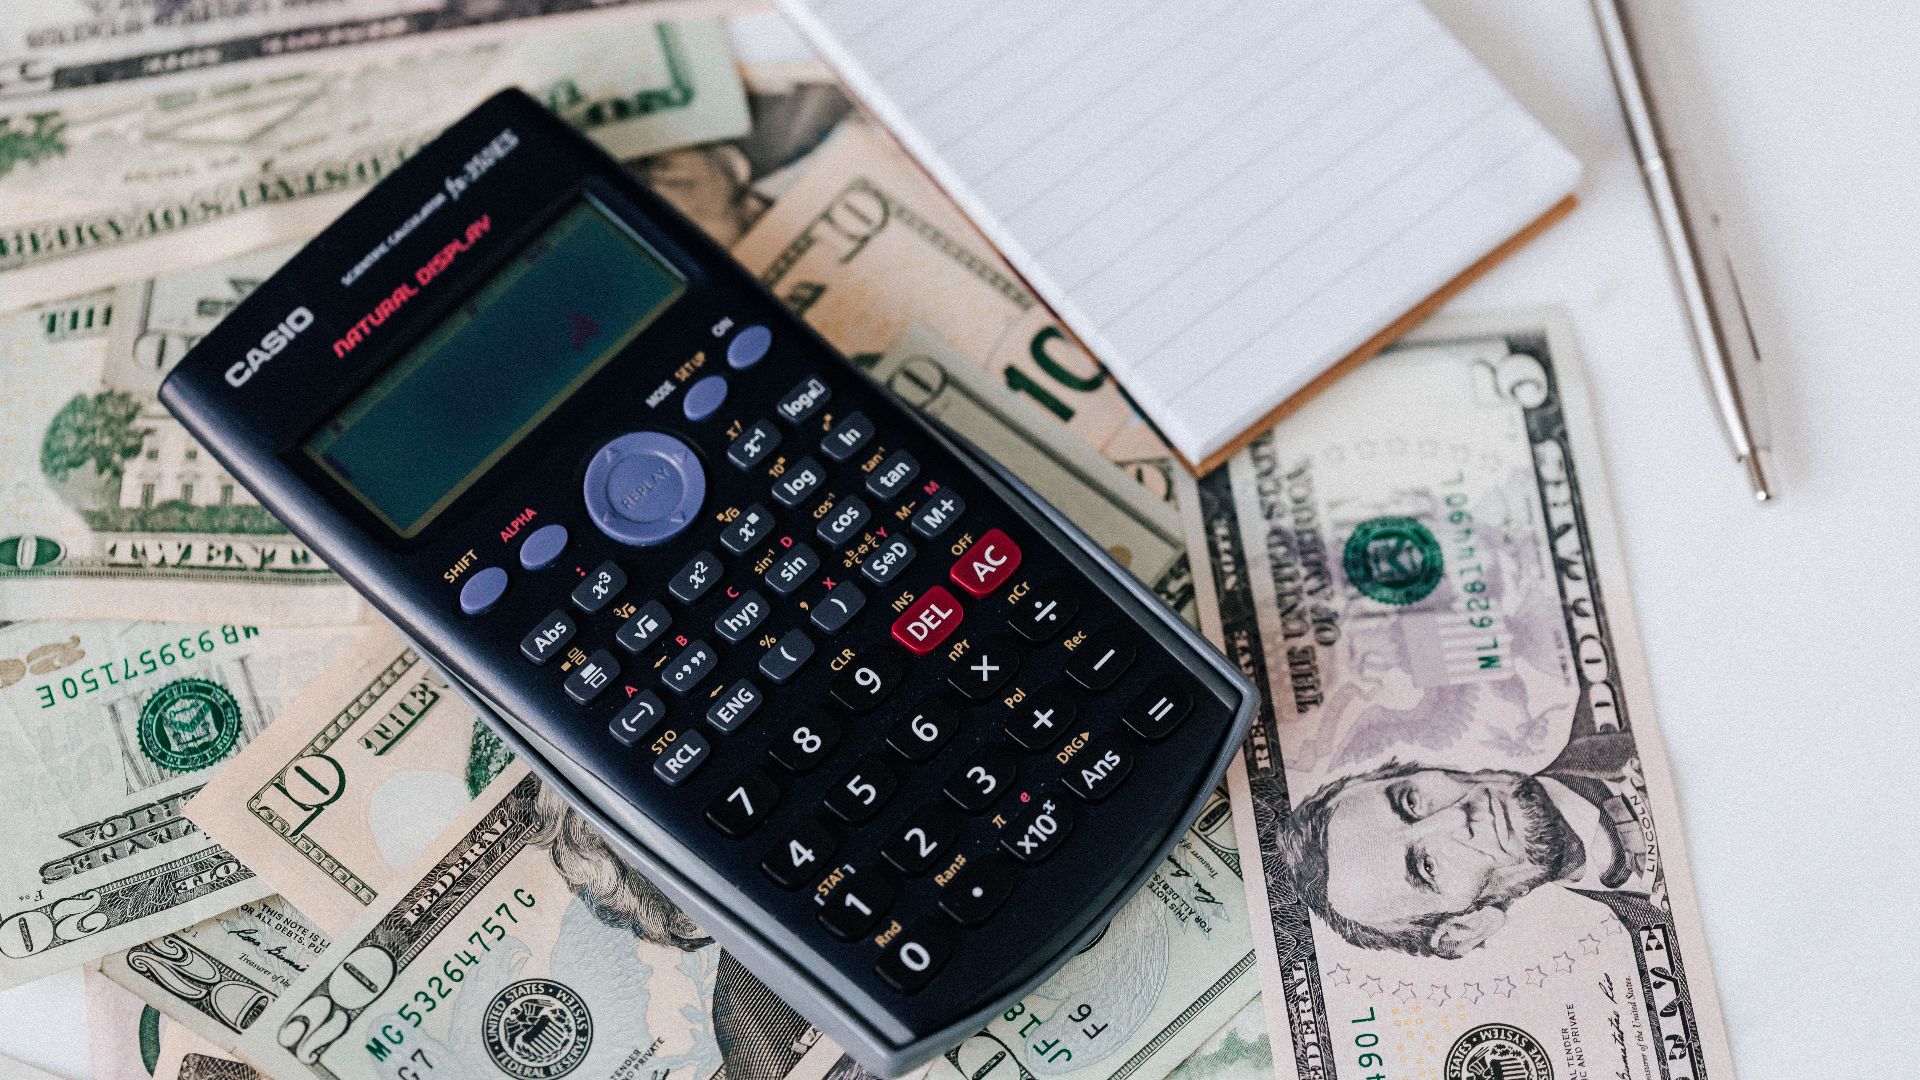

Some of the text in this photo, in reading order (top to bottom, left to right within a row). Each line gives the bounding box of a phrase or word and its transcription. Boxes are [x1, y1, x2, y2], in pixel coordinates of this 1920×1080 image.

[332, 212, 492, 359] NATURAL DISPLAY
[711, 316, 735, 338] ON
[224, 306, 315, 388] CASIO
[645, 379, 677, 408] MODE
[838, 427, 862, 447] ln
[622, 466, 671, 510] REPLAY
[783, 469, 817, 496] log
[880, 461, 910, 488] tan
[923, 480, 940, 496] M
[500, 507, 538, 543] ALPHA
[832, 507, 860, 533] cos
[923, 498, 954, 529] M+
[780, 536, 793, 548] D
[876, 527, 889, 540] Y
[951, 532, 974, 556] OFF
[443, 548, 478, 583] SHIFT
[780, 556, 807, 581] sin
[972, 544, 1008, 583] AC
[726, 586, 740, 599] C
[891, 591, 915, 613] INS
[1007, 581, 1031, 605] nCr
[724, 601, 759, 632] hyp
[906, 603, 953, 641] DEL
[534, 621, 567, 653] Abs
[675, 634, 688, 647] B
[759, 634, 777, 649] %
[948, 638, 971, 662] nPr
[1063, 630, 1088, 652] Rec
[830, 648, 856, 671] CLR
[624, 685, 638, 698] A
[854, 667, 882, 695] 9
[1287, 645, 1324, 714] THE
[717, 687, 755, 724] ENG
[1004, 687, 1027, 709] Pol
[651, 730, 677, 755] STO
[792, 726, 822, 754] 8
[911, 714, 939, 742] 6
[665, 743, 702, 775] RCL
[1081, 750, 1121, 790] Ans
[846, 774, 877, 806] 5
[966, 765, 997, 795] 3
[727, 786, 754, 816] 7
[1020, 792, 1031, 803] e
[904, 827, 938, 858] 2
[1630, 795, 1657, 873] LINCOLN
[39, 817, 203, 884] TATES
[789, 839, 815, 868] 4
[402, 815, 518, 928] FEDERAL
[934, 854, 967, 887] Ran#
[844, 893, 872, 916] 1
[1147, 881, 1169, 905] NOTE
[1178, 899, 1196, 916] ALL
[0, 889, 109, 960] 20
[255, 911, 272, 927] ALL
[261, 904, 283, 921] THIS
[283, 917, 311, 938] NOTE
[309, 932, 321, 944] IS
[1169, 904, 1188, 923] THIS
[1194, 915, 1213, 934] FOR
[874, 920, 903, 948] Rnd
[238, 952, 271, 977] Treasurer
[899, 941, 931, 972] 0
[276, 944, 399, 1066] 20
[487, 983, 546, 1043] UNITED STATES
[1628, 1002, 1642, 1030] United
[496, 989, 588, 1079] FEDERAL RESERVE SYSTEM
[1068, 1003, 1109, 1040] F6
[1566, 1003, 1587, 1068] AND PRIVATE
[1480, 1028, 1529, 1048] SYSTEM
[1561, 1028, 1577, 1068] TENDER
[610, 1049, 642, 1080] TENDER
[633, 1036, 665, 1072] PRIVATE
[1450, 1041, 1473, 1079] STATES
